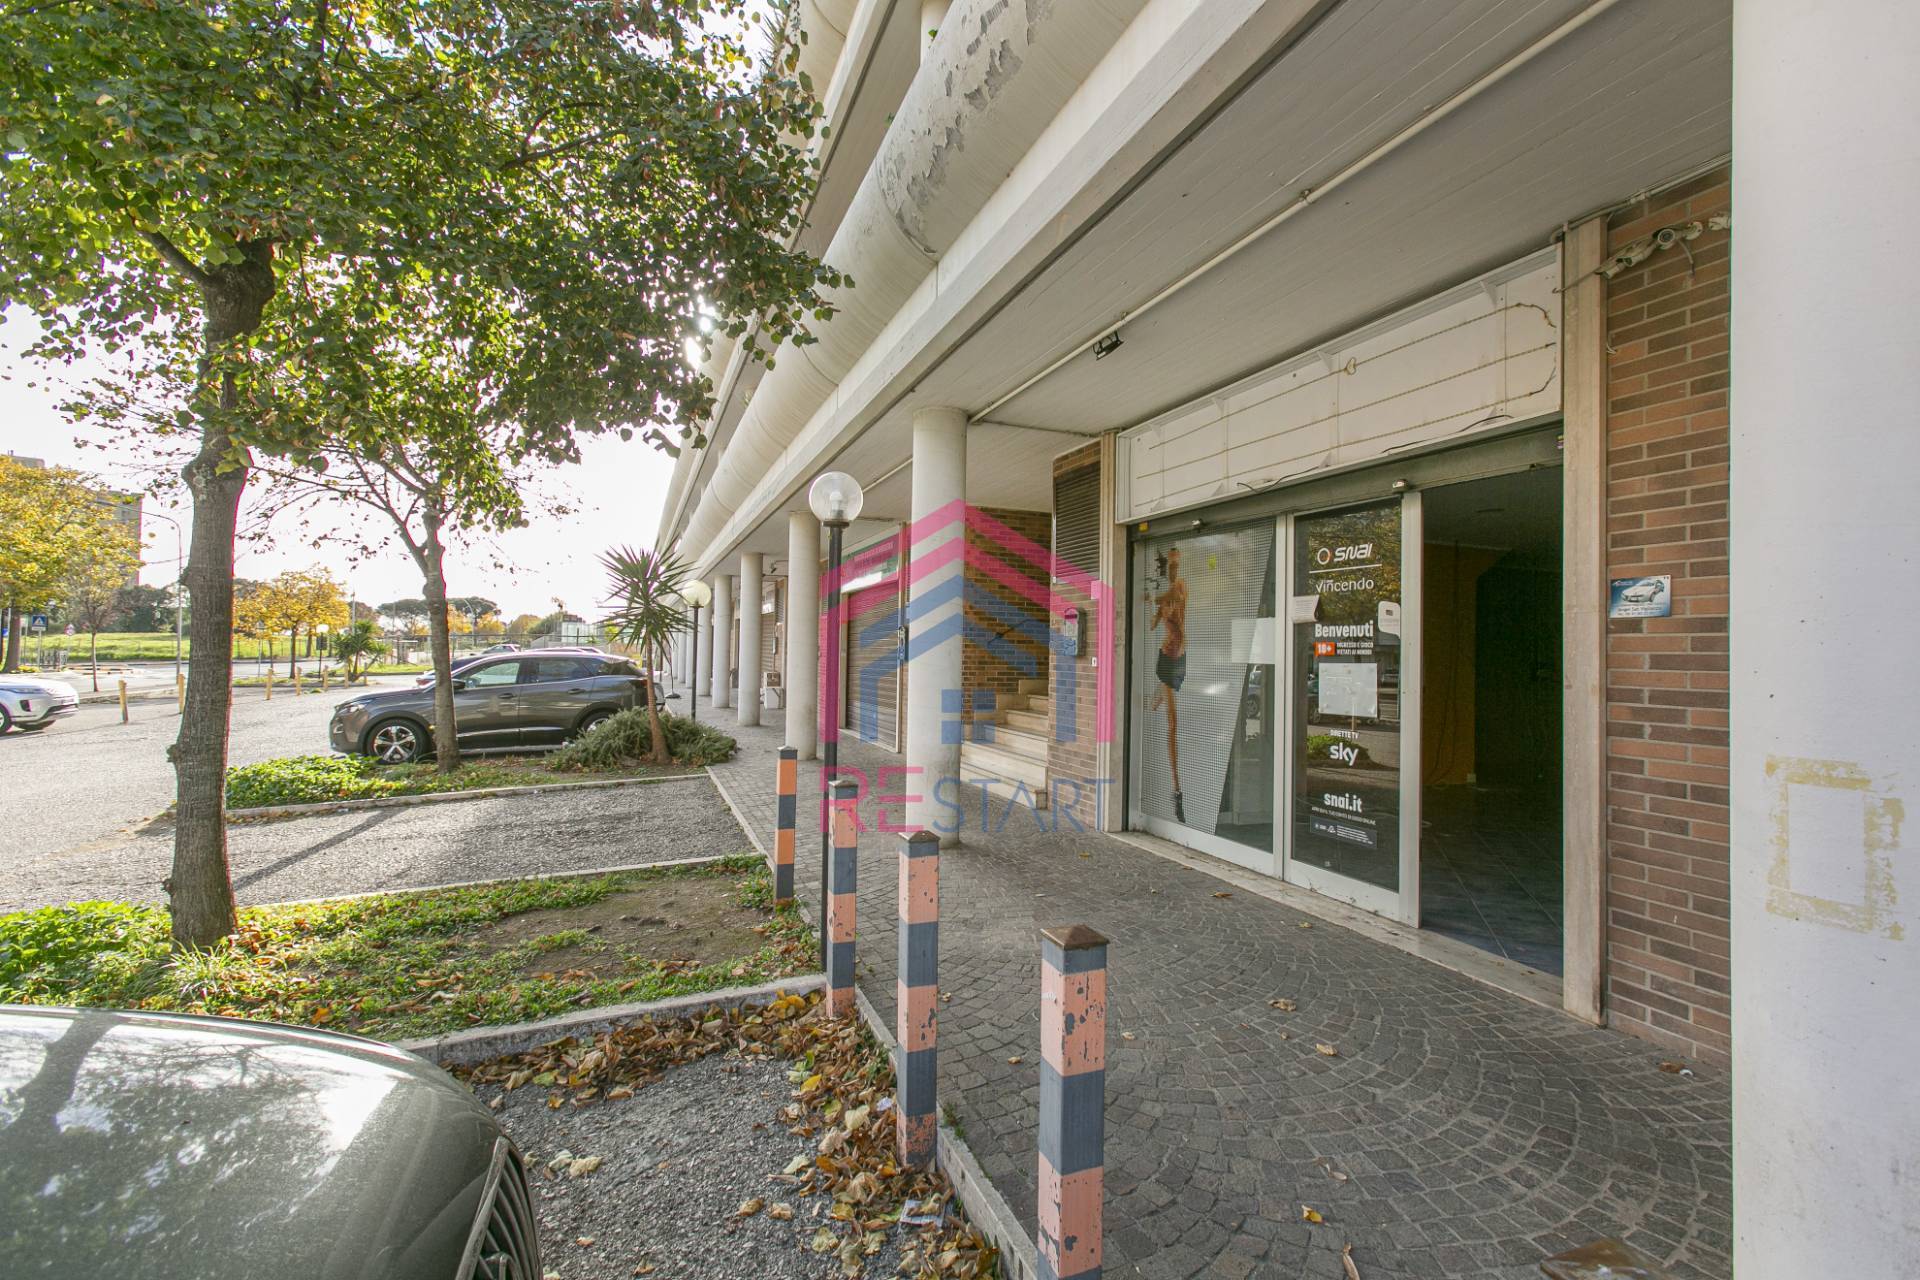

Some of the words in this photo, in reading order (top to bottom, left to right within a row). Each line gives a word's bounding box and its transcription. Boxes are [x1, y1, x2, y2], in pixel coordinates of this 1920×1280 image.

[1315, 620, 1374, 637] Benvenuti
[1317, 642, 1332, 655] 18+
[1330, 742, 1359, 765] sky
[1323, 793, 1363, 813] snai.it
